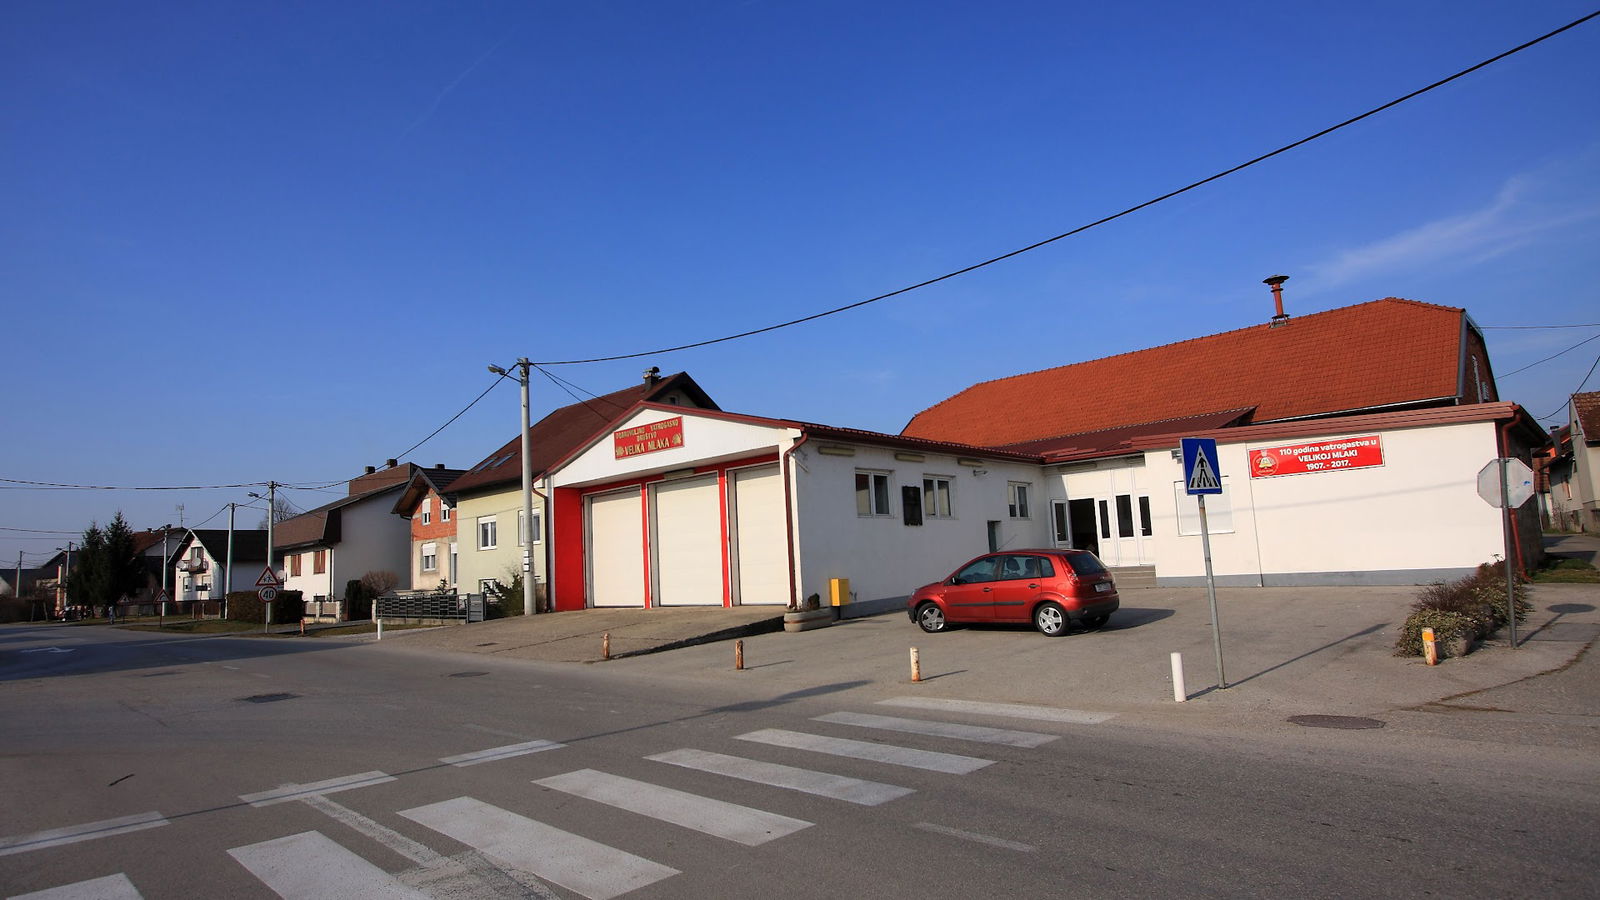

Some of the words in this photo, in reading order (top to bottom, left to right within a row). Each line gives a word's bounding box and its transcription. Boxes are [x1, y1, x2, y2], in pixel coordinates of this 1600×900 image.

[625, 442, 645, 455] VELIKA
[647, 437, 670, 450] MLAKA
[1279, 448, 1292, 456] 110
[1293, 446, 1320, 456] godina
[1320, 440, 1369, 451] vatrogastva
[1298, 453, 1331, 463] VELIKOJ
[1332, 449, 1358, 459] MLAKI
[1306, 462, 1326, 471] 1907.
[1331, 460, 1351, 469] 2017.
[263, 590, 274, 599] 40
